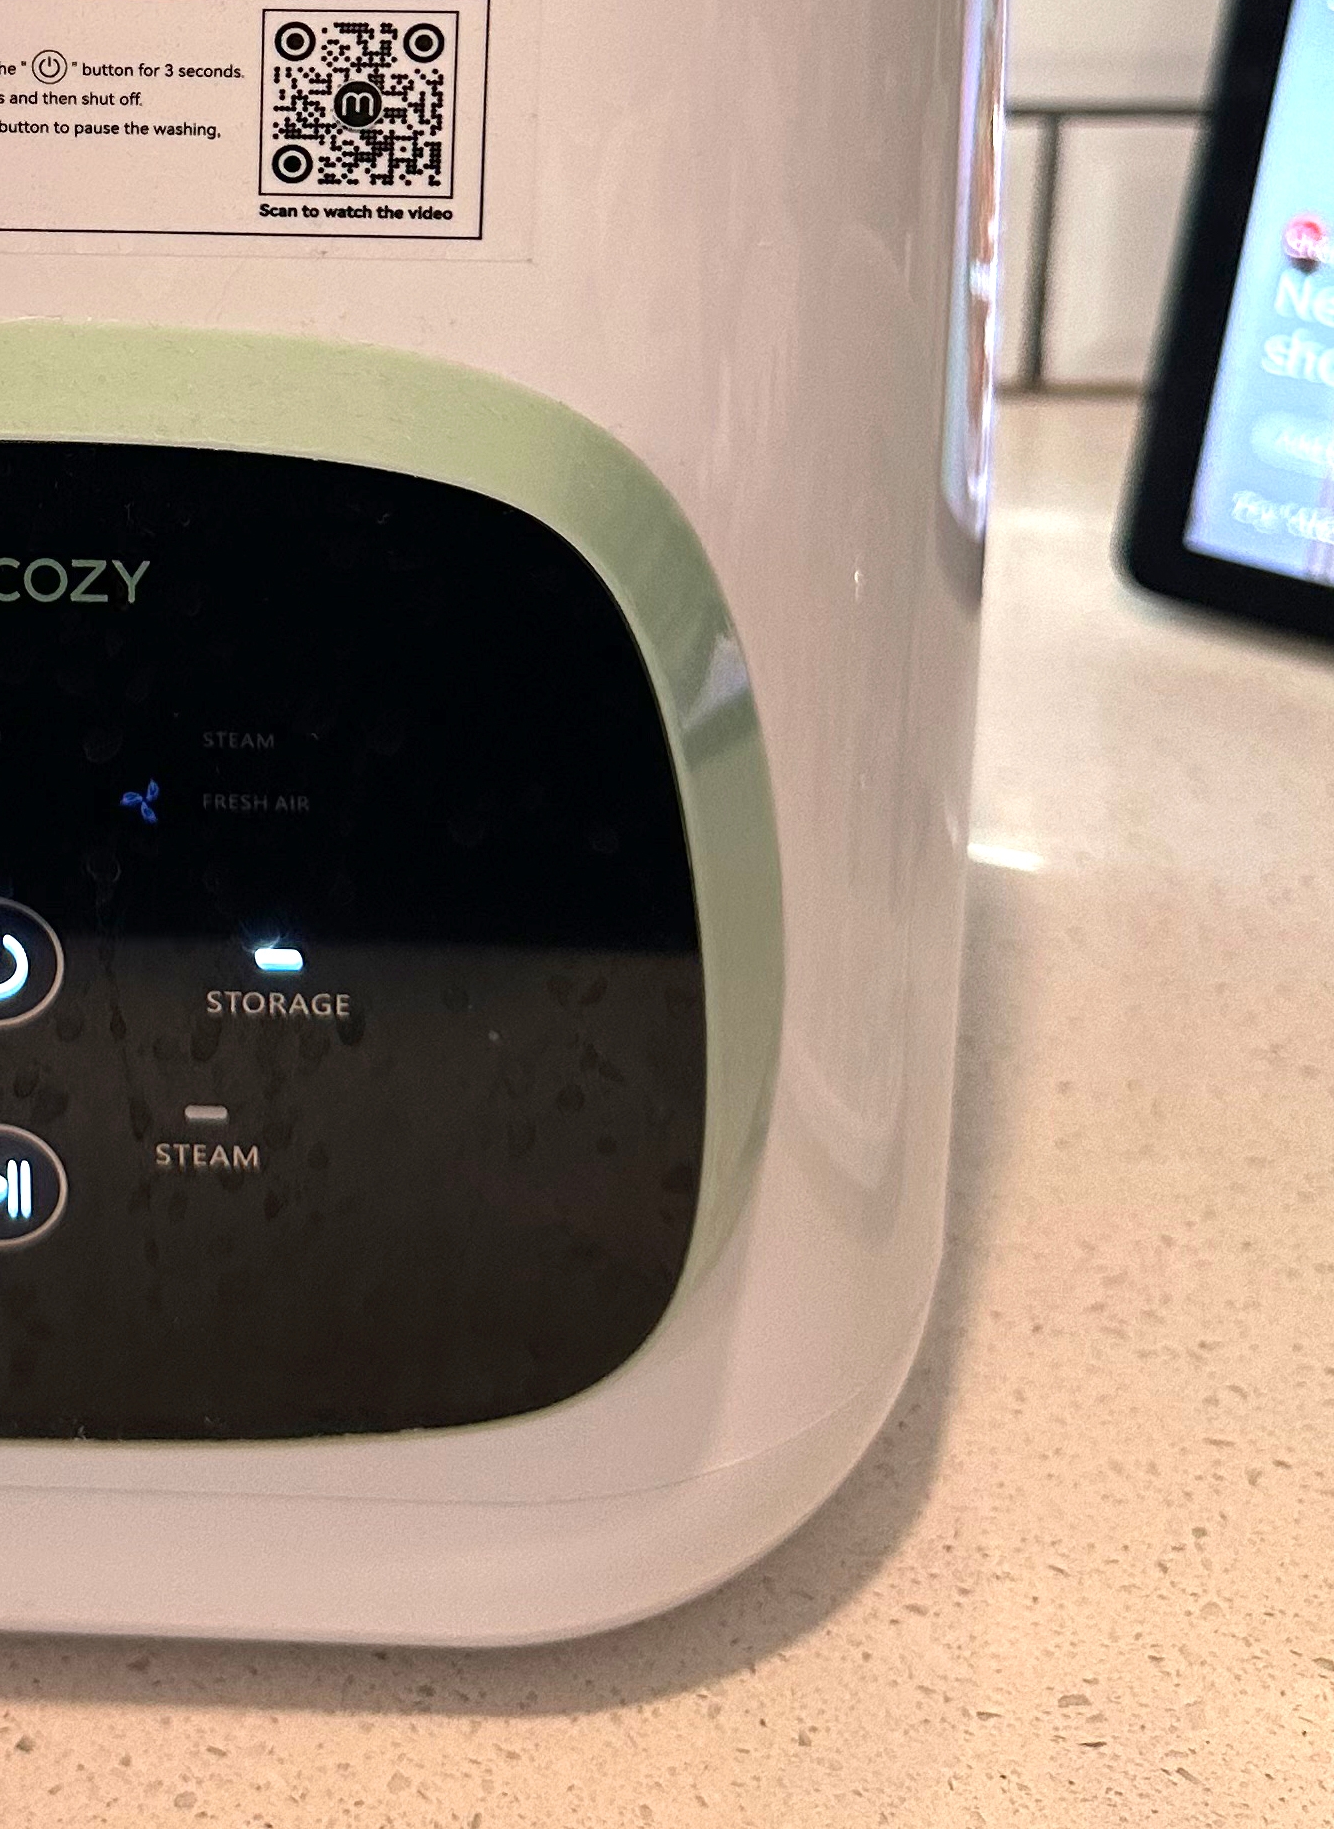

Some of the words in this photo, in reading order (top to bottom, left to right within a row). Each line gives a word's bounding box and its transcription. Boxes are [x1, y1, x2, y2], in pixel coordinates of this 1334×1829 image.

[82, 62, 133, 76] button
[138, 63, 160, 77] for
[165, 63, 173, 77] 3
[178, 64, 244, 78] seconds.
[10, 91, 38, 104] and
[42, 91, 77, 105] then
[81, 92, 115, 105] shut
[120, 92, 142, 106] off.
[53, 122, 69, 134] to
[74, 124, 119, 138] pause
[124, 121, 149, 135] the
[153, 122, 221, 140] washing,
[259, 203, 298, 218] Scan
[301, 205, 320, 218] to
[323, 205, 373, 219] watch
[376, 205, 404, 220] the
[408, 206, 453, 220] video
[203, 731, 276, 750] STEAM
[203, 793, 268, 812] FRESH
[275, 795, 312, 813] AIR
[206, 990, 350, 1019] STORAGE
[155, 1143, 260, 1169] STEAM
